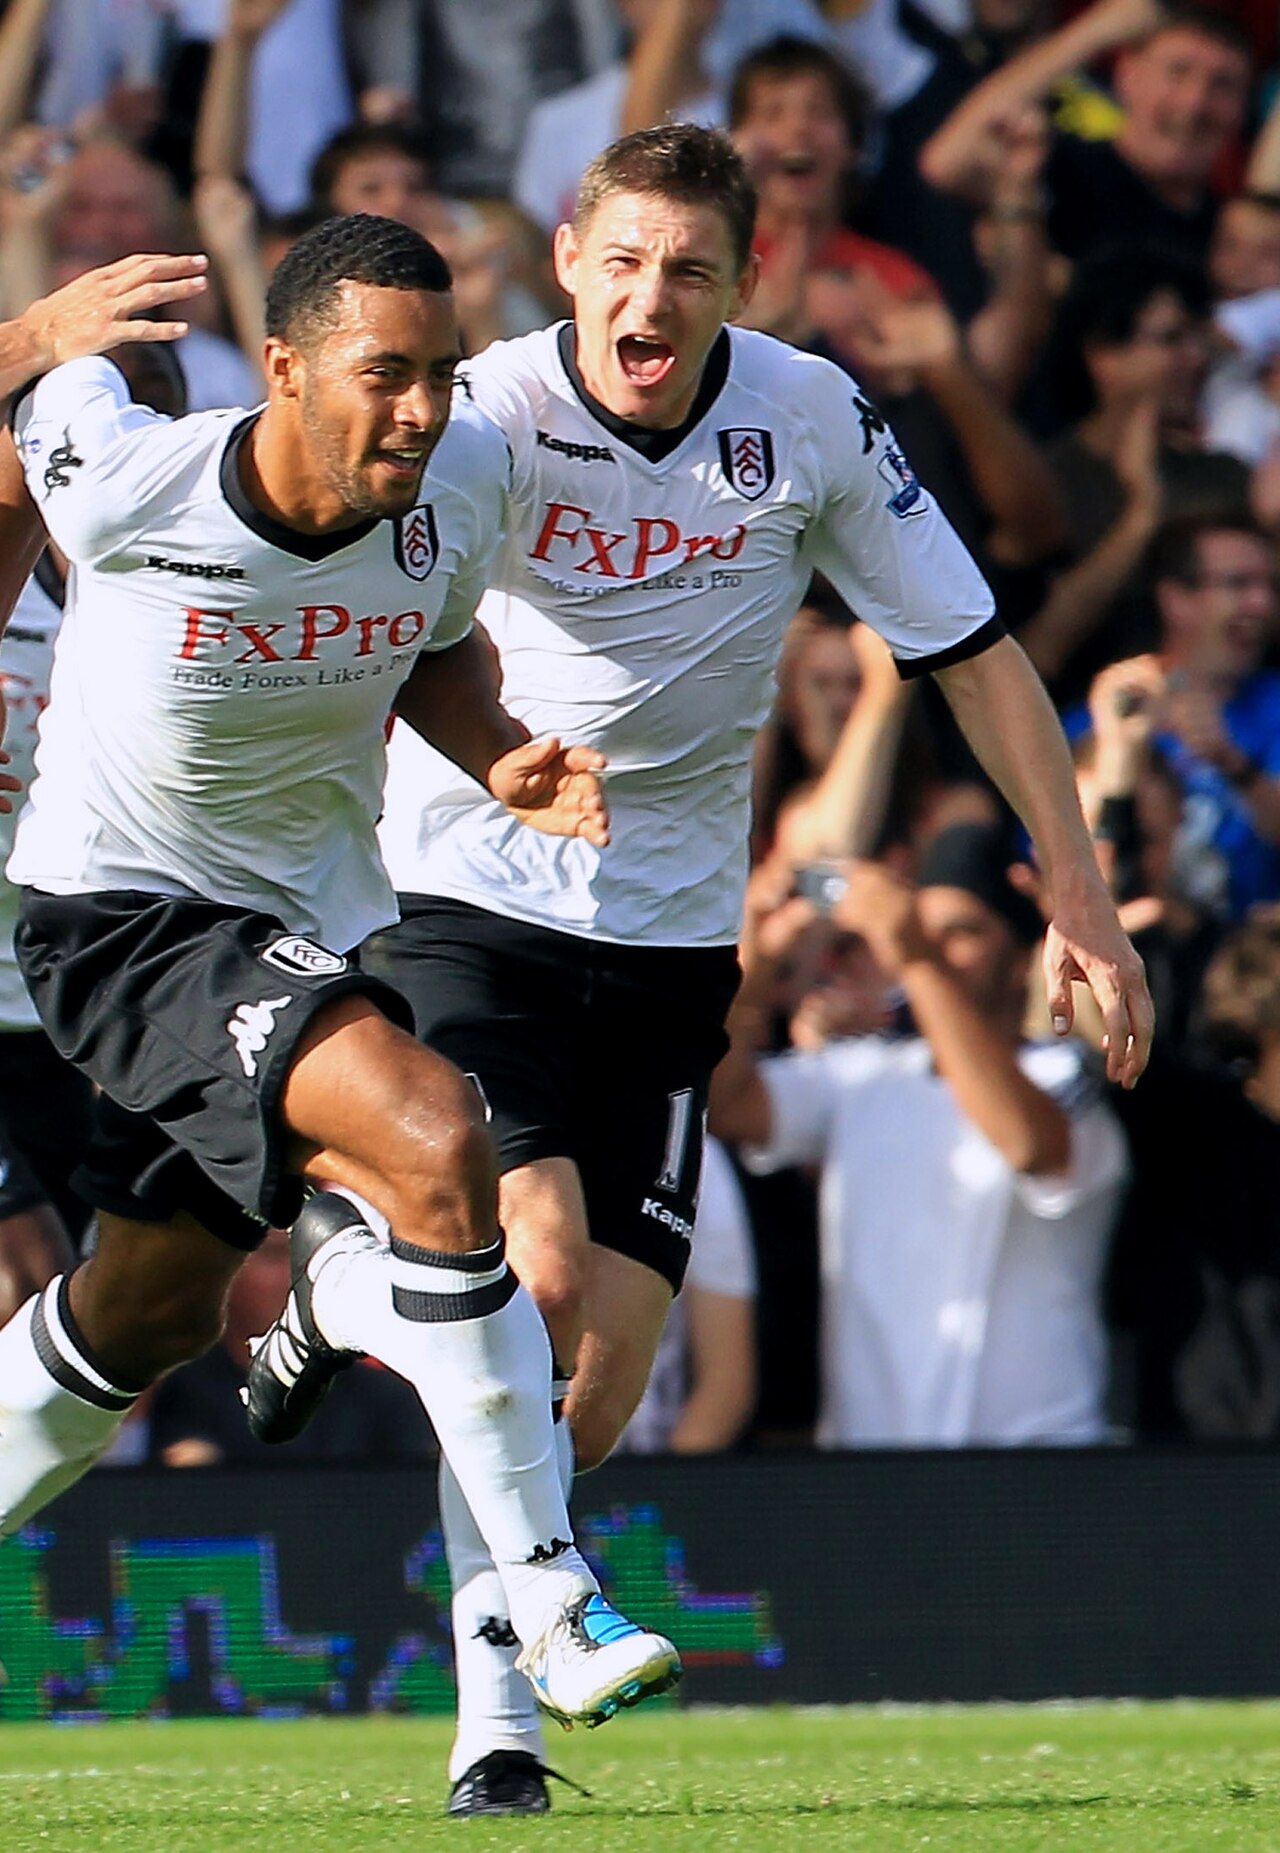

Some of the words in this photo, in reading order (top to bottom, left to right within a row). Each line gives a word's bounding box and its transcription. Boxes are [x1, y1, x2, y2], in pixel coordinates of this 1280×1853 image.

[536, 430, 616, 464] Kappa
[528, 502, 746, 579] FxPro
[145, 555, 245, 579] Kappa
[712, 570, 742, 589] Pro
[174, 603, 425, 664] FxPro
[241, 670, 307, 689] Forex
[319, 668, 365, 686] Like
[372, 665, 383, 676] a
